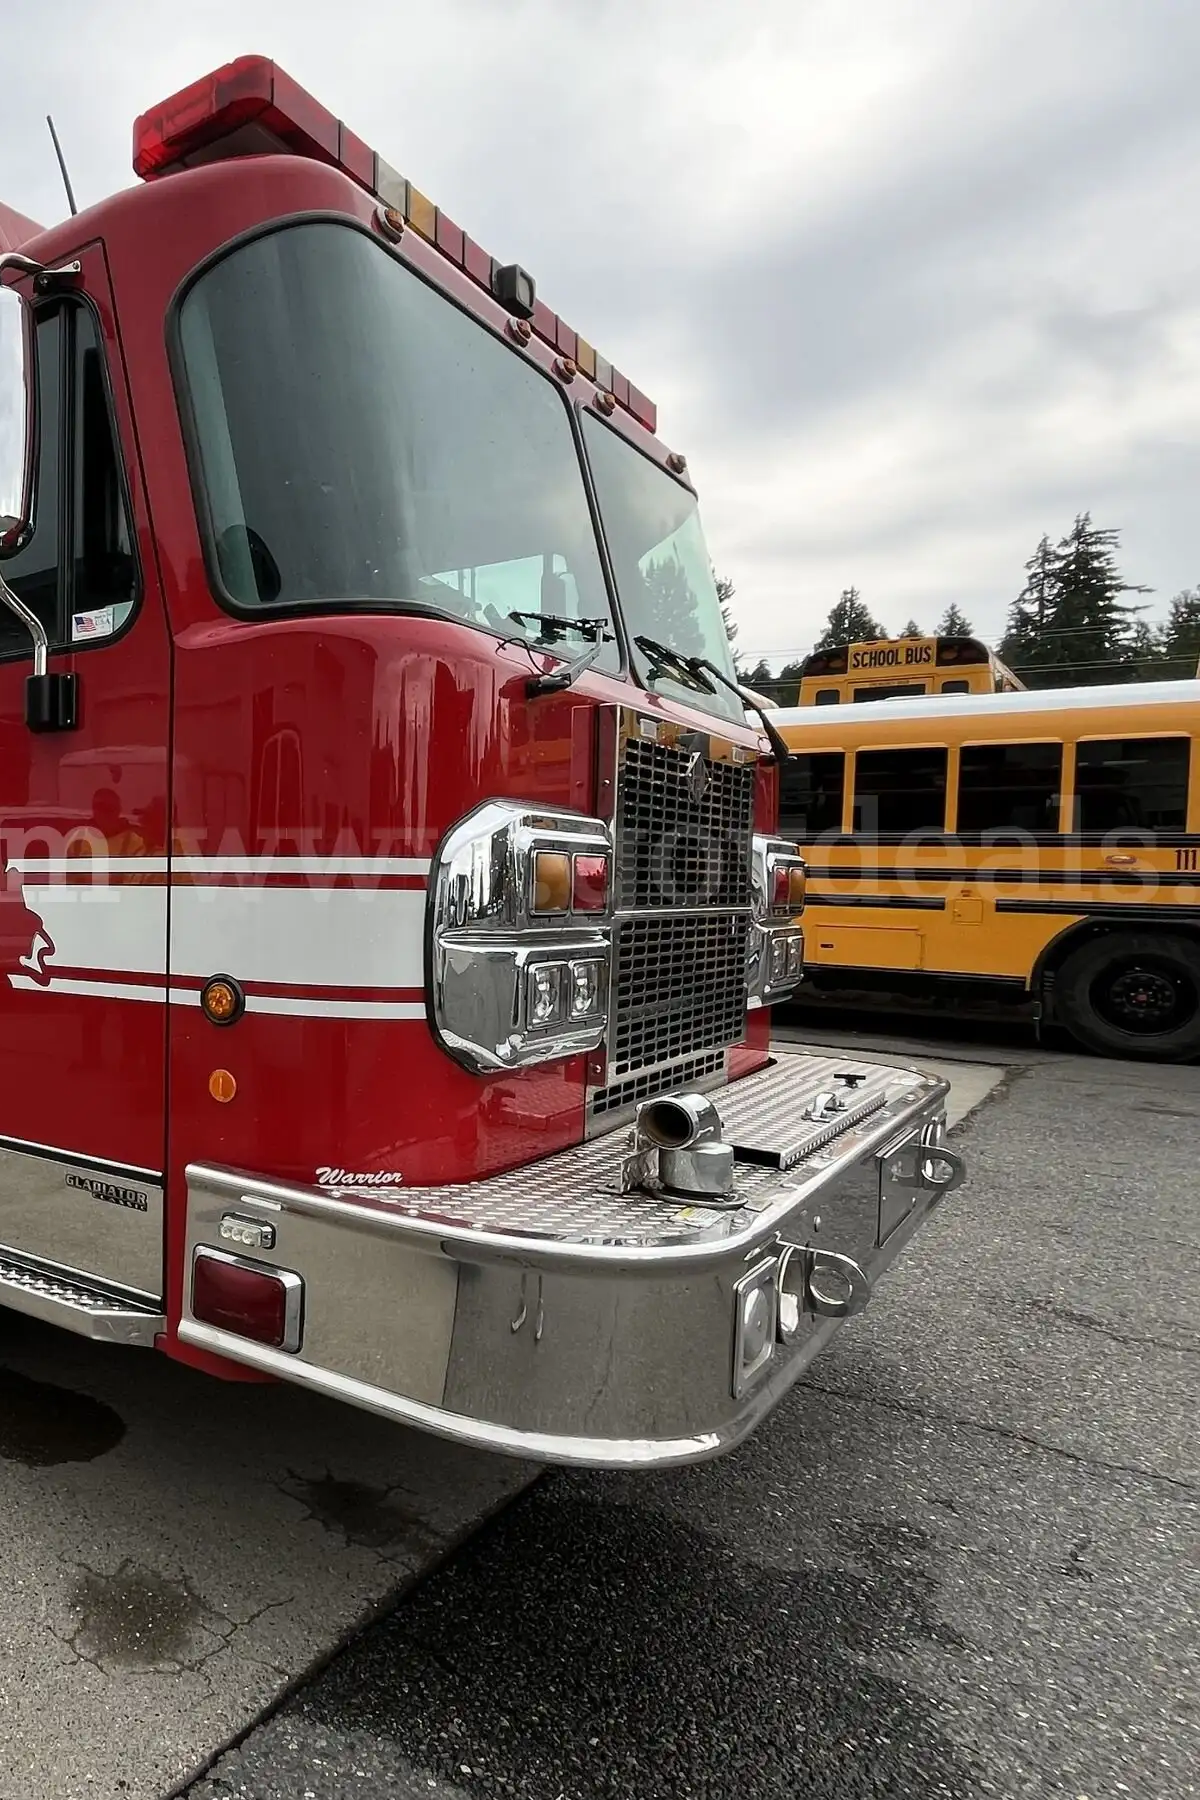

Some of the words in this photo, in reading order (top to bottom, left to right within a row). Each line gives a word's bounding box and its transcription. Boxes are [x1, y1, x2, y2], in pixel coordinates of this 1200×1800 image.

[852, 648, 902, 668] SCHOOL
[905, 645, 932, 665] BUS
[315, 1166, 403, 1185] Warrior
[65, 1173, 147, 1205] GLADIATOR
